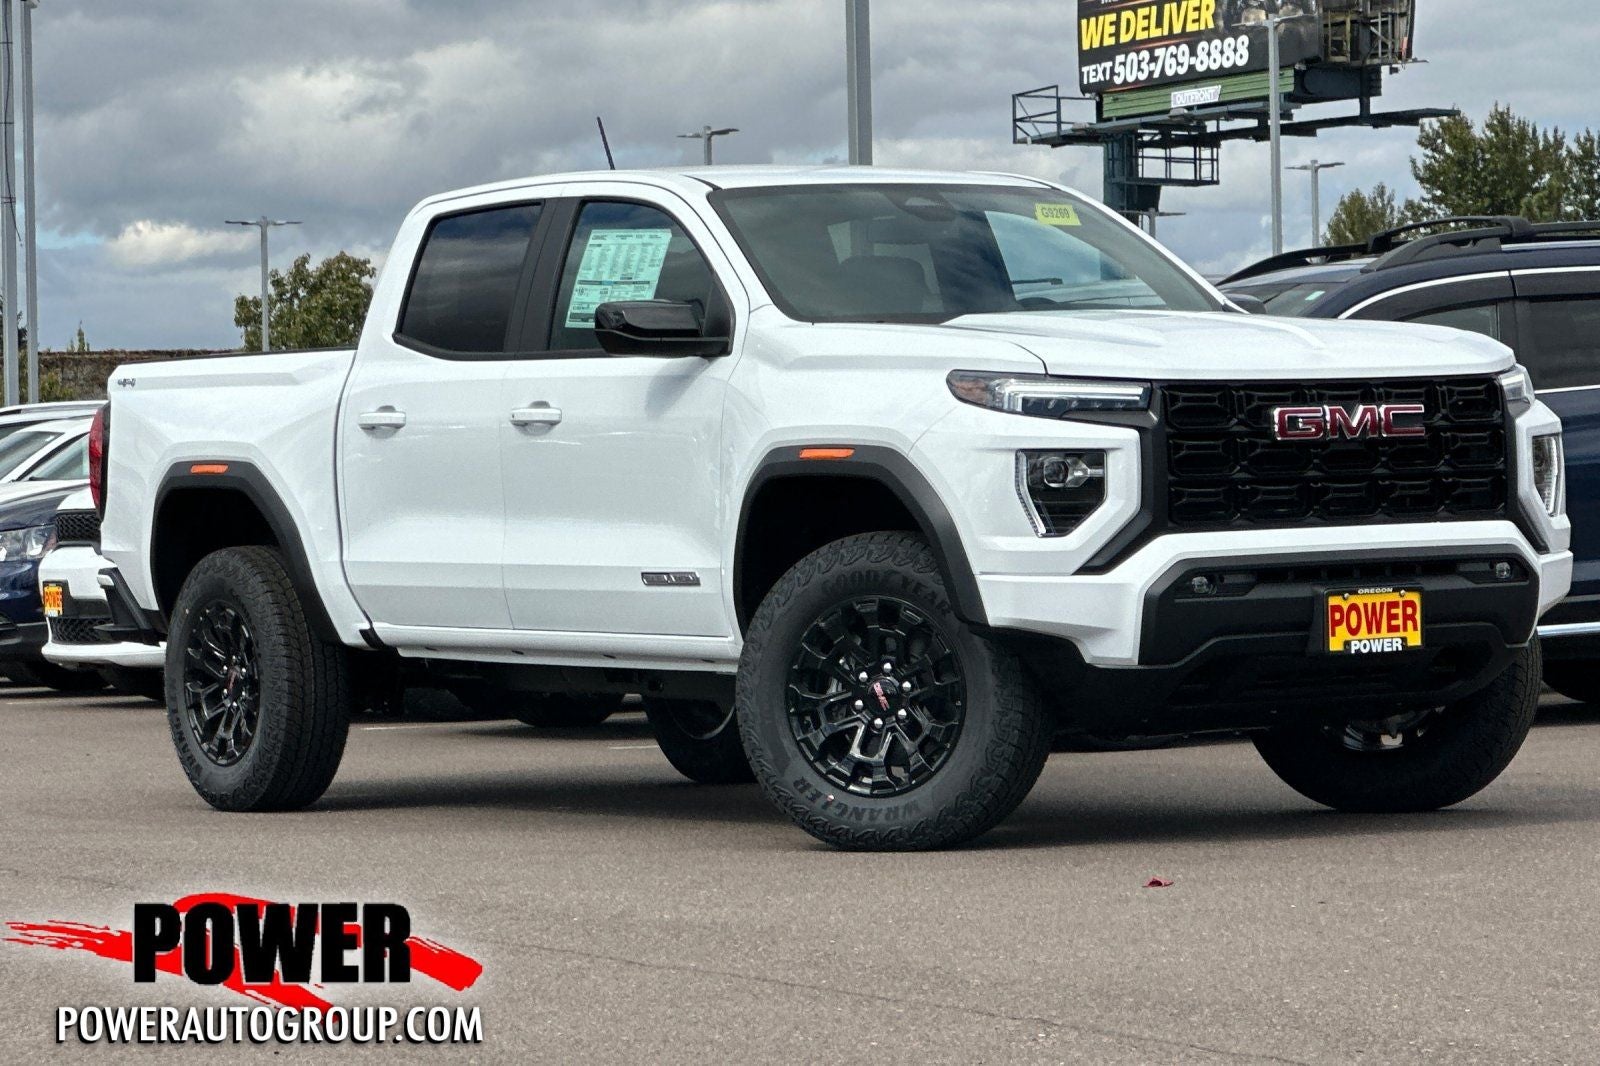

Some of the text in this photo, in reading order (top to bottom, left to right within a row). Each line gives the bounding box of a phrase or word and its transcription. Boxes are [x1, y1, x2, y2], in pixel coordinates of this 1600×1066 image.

[1081, 0, 1215, 50] WE DELIVER
[1082, 34, 1249, 84] TEXT 503-769-8888
[1274, 404, 1425, 440] GMC
[1330, 600, 1418, 637] POWER
[1351, 637, 1403, 654] POWER
